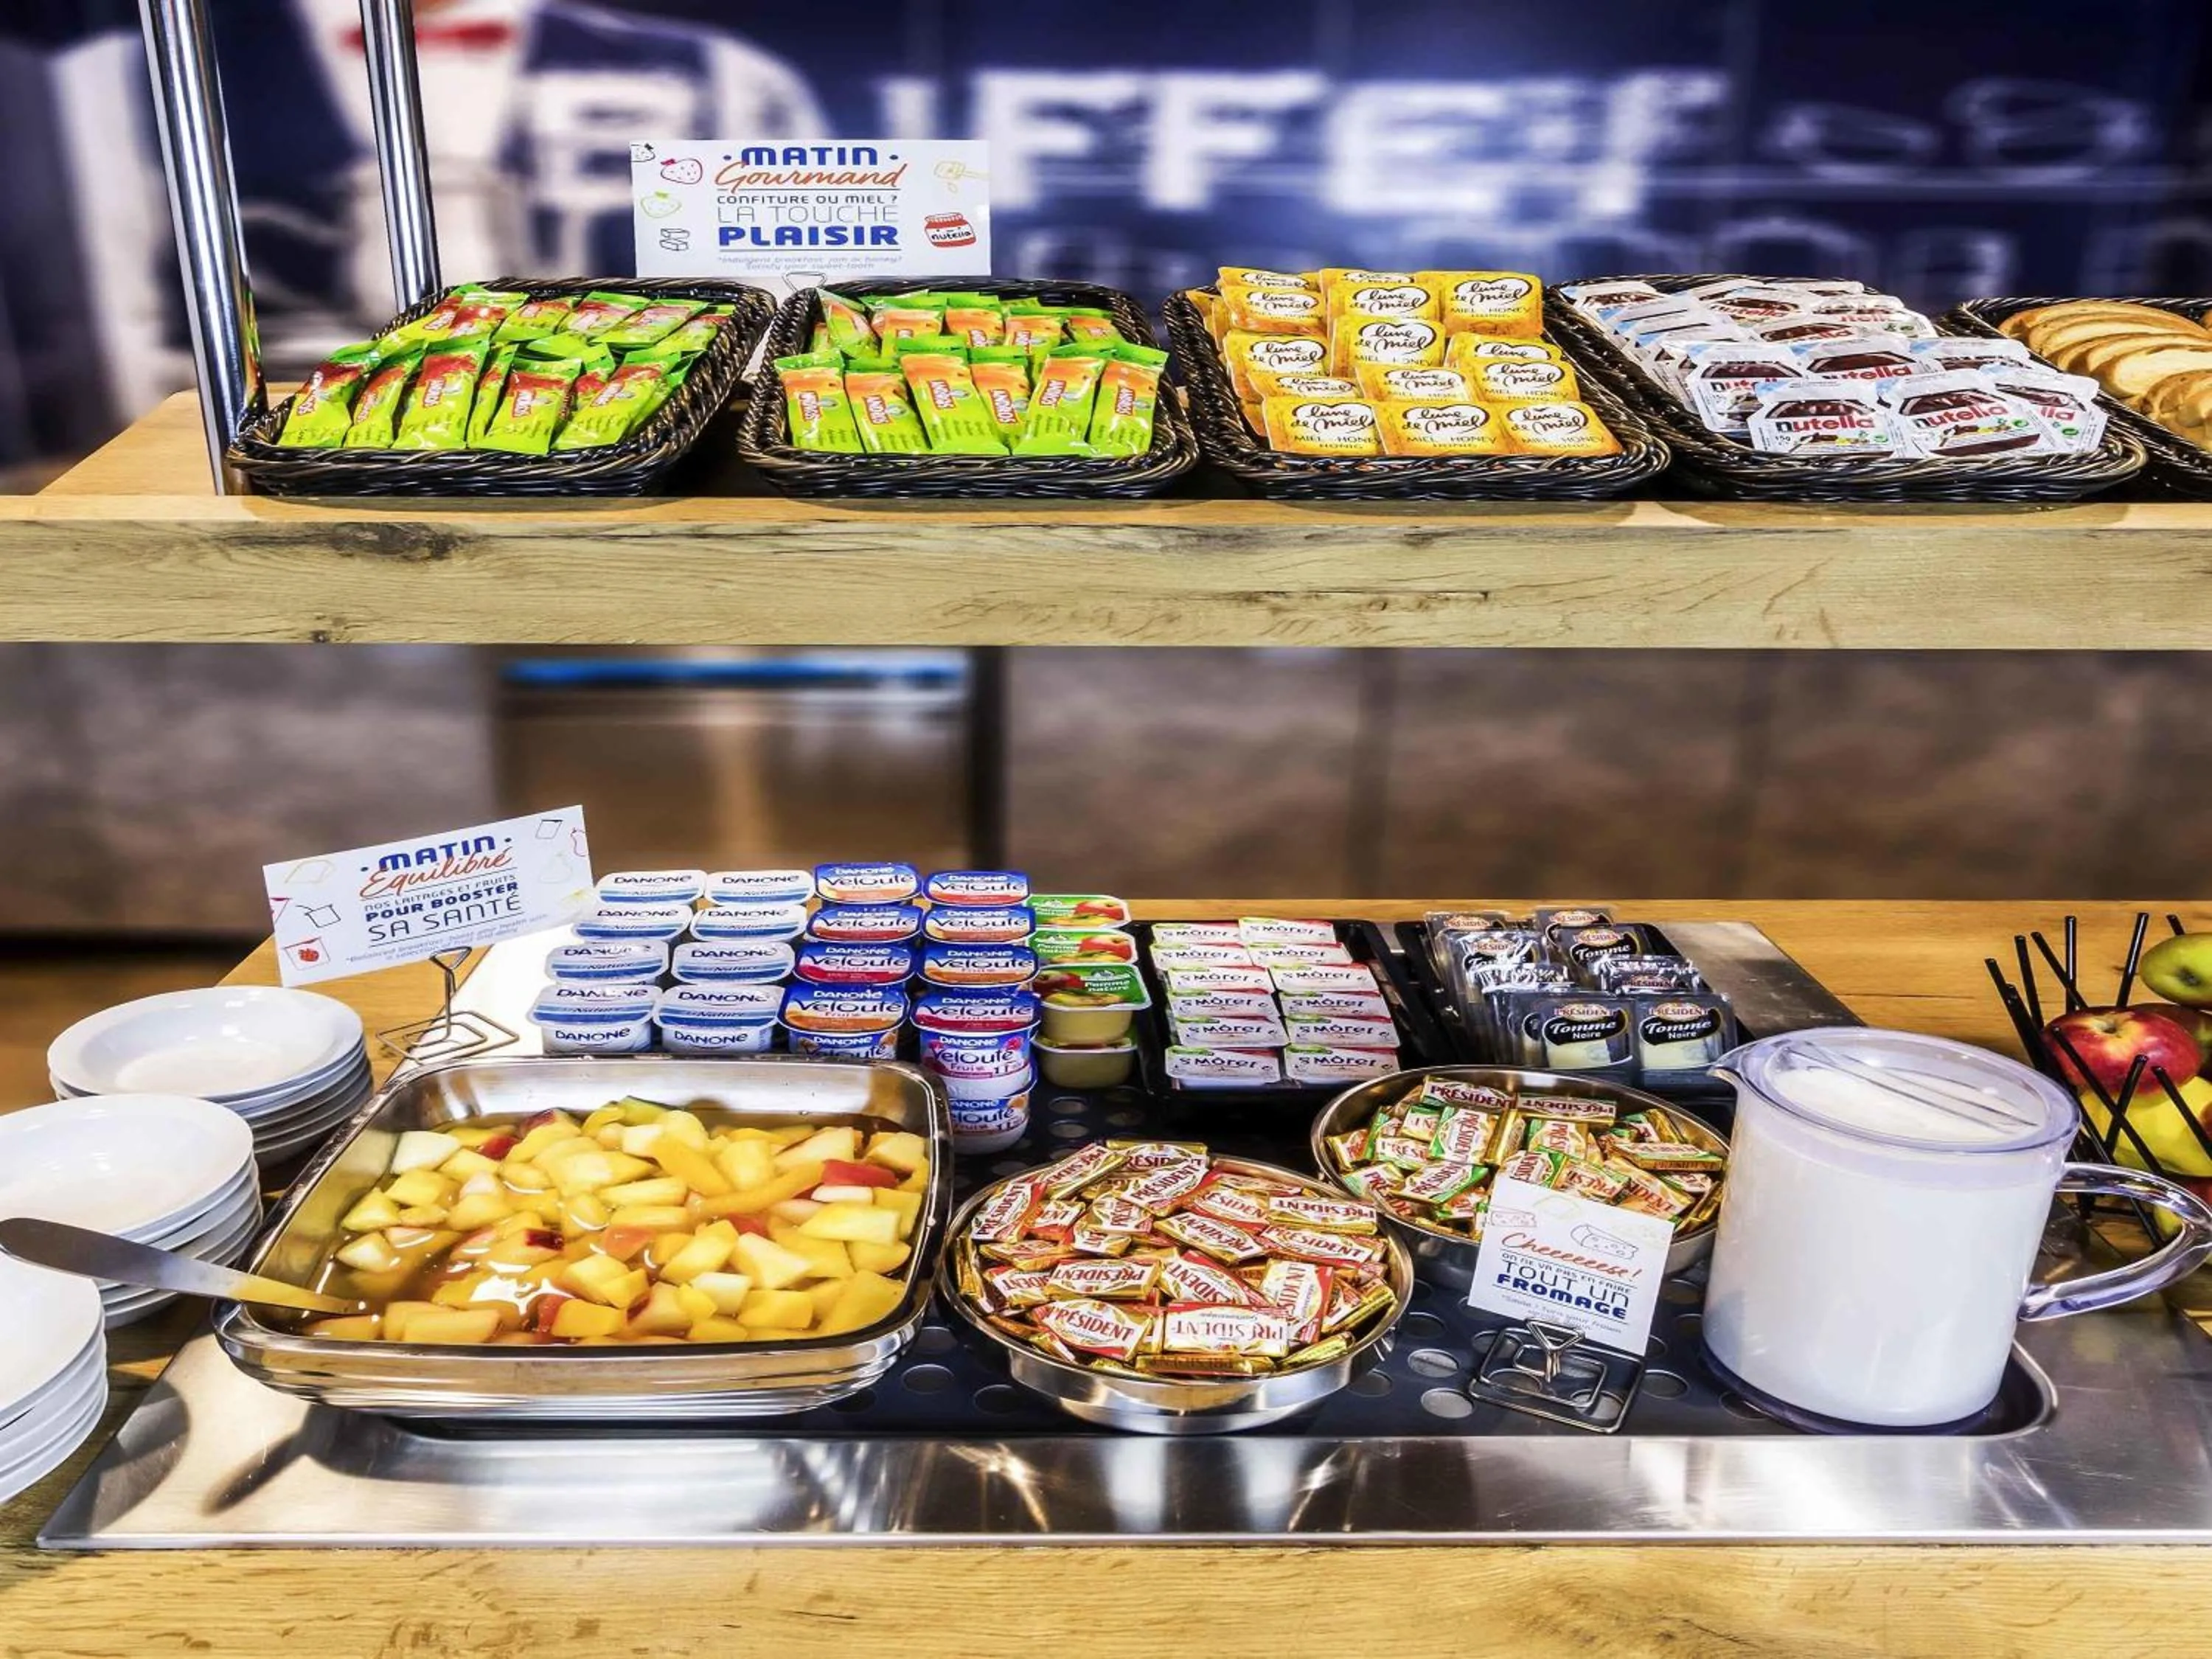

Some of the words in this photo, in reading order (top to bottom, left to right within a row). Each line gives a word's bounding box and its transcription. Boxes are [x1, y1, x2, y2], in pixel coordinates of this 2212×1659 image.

[741, 147, 877, 166] MATIN
[714, 161, 908, 194] Gourmand
[717, 195, 809, 204] CONFITURE
[816, 195, 838, 204] OU
[845, 195, 885, 204] MIEL
[717, 206, 754, 223] LA
[768, 206, 899, 223] TOUCHE
[718, 226, 899, 246] PLAISIR
[1467, 281, 1509, 293] lune
[1368, 290, 1407, 302] lune
[1469, 288, 1523, 305] miel
[1368, 298, 1422, 313] miel
[1374, 324, 1413, 337] lune
[1265, 342, 1303, 352] lune
[1374, 336, 1427, 352] miel
[1482, 343, 1528, 356] lune
[1269, 351, 1318, 367] miel
[1500, 364, 1540, 374] lune
[1503, 372, 1556, 388] miel
[1305, 407, 1352, 418] lune
[1417, 408, 1463, 420] lune
[1522, 409, 1564, 420] lune
[1911, 405, 2008, 428] nutella
[1312, 414, 1369, 434] miel
[1424, 417, 1480, 434] miel
[1531, 417, 1580, 435] miel
[1775, 417, 1875, 434] nutella
[378, 835, 496, 871] MATIN
[614, 874, 692, 884] DANONE
[723, 875, 799, 884] DANONE
[395, 888, 454, 906] LAITAGES
[458, 883, 470, 893] ET
[475, 874, 516, 889] FRUITS
[365, 903, 423, 922] POUR
[431, 882, 518, 909] BOOSTER
[369, 920, 410, 942] SA
[422, 891, 522, 931] SANTÉ
[597, 909, 679, 917] DANONE
[825, 946, 891, 955] DANONE
[813, 990, 883, 999] DANONE
[555, 1028, 631, 1041] DANONE
[1549, 1021, 1617, 1034] Tomme
[1644, 1020, 1711, 1034] Tomme
[674, 1030, 748, 1046] DANONE
[813, 1036, 873, 1046] DANONE
[939, 1036, 998, 1046] DANONE
[1572, 1032, 1601, 1040] Noire
[932, 1048, 1013, 1064] Velouté
[1430, 1085, 1516, 1107] PRÉSIDENT
[1502, 1253, 1517, 1262] ON
[1502, 1259, 1577, 1291] TOUT
[1589, 1285, 1630, 1308] UN
[1497, 1273, 1627, 1320] FROMAGE
[1046, 1306, 1135, 1341] PRÉSIDENT
